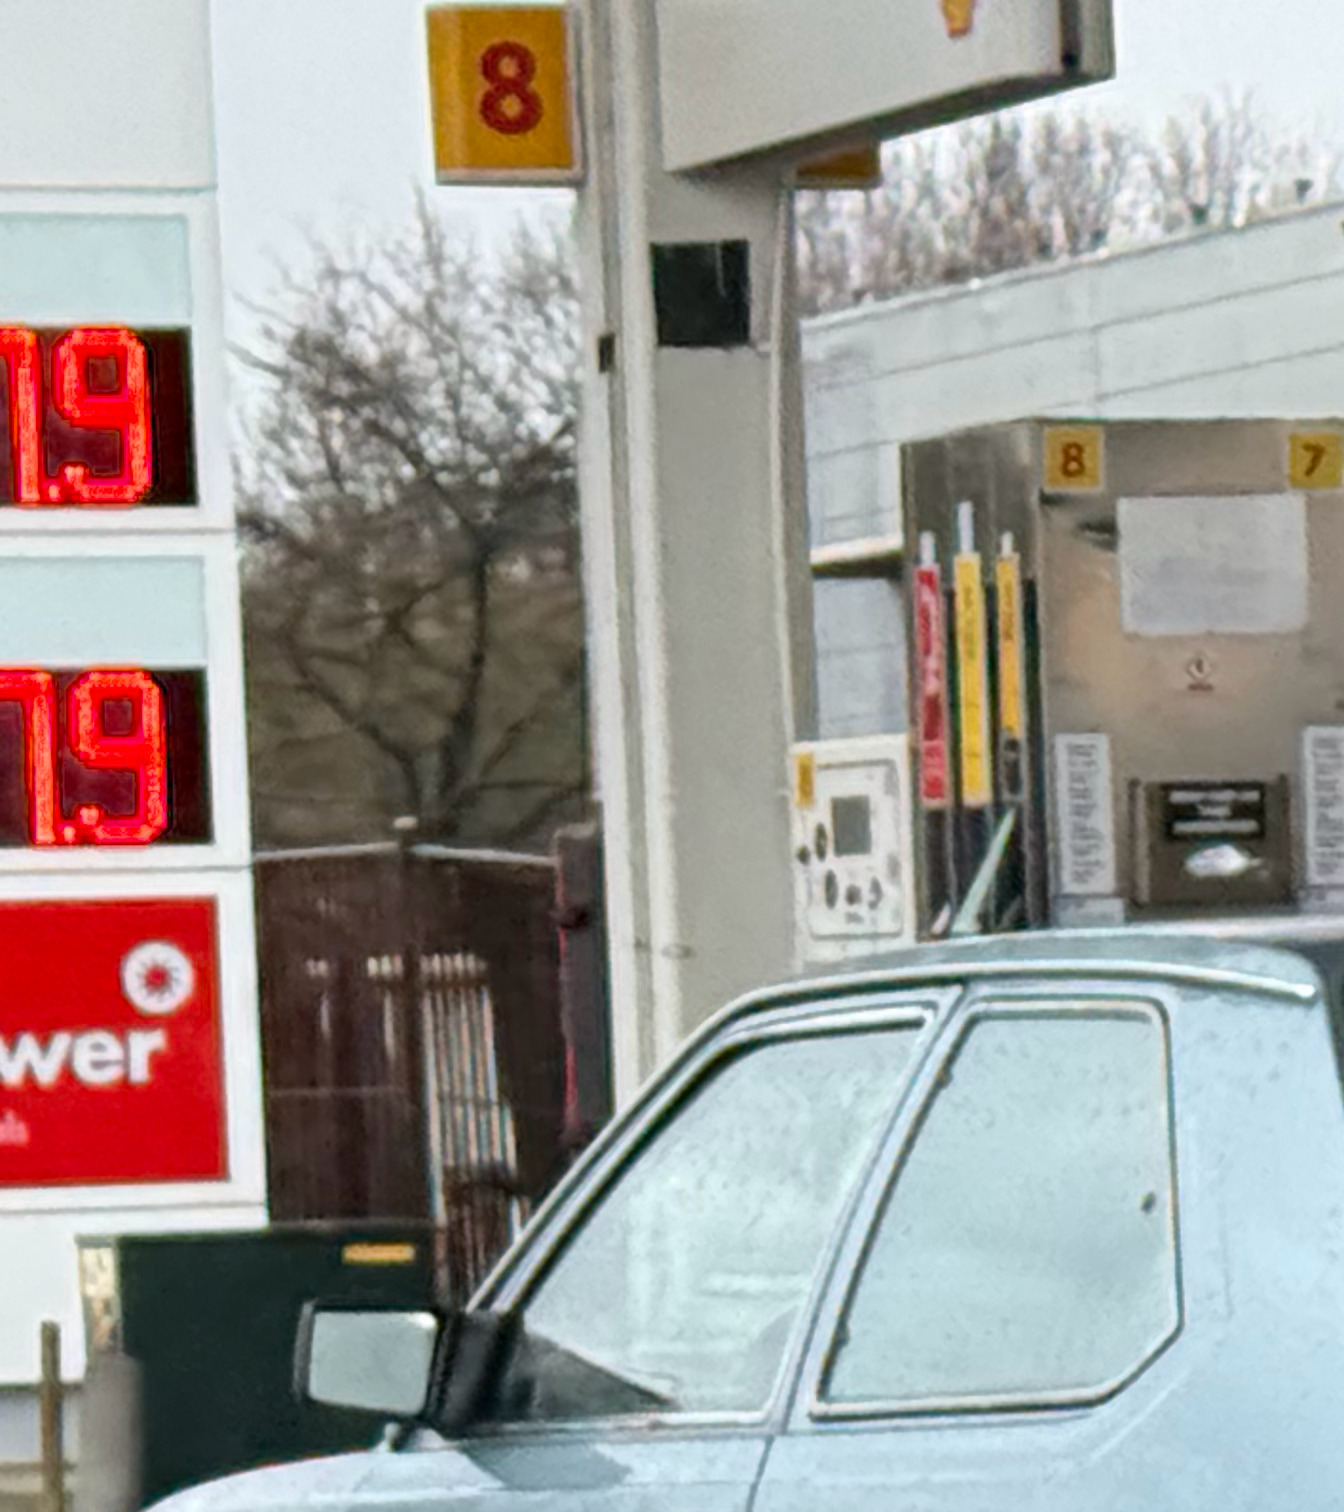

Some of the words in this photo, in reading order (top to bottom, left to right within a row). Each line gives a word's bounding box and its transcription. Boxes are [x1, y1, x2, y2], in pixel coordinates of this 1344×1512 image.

[479, 41, 542, 135] 8
[1061, 442, 1086, 478] 8
[1302, 444, 1326, 478] 7
